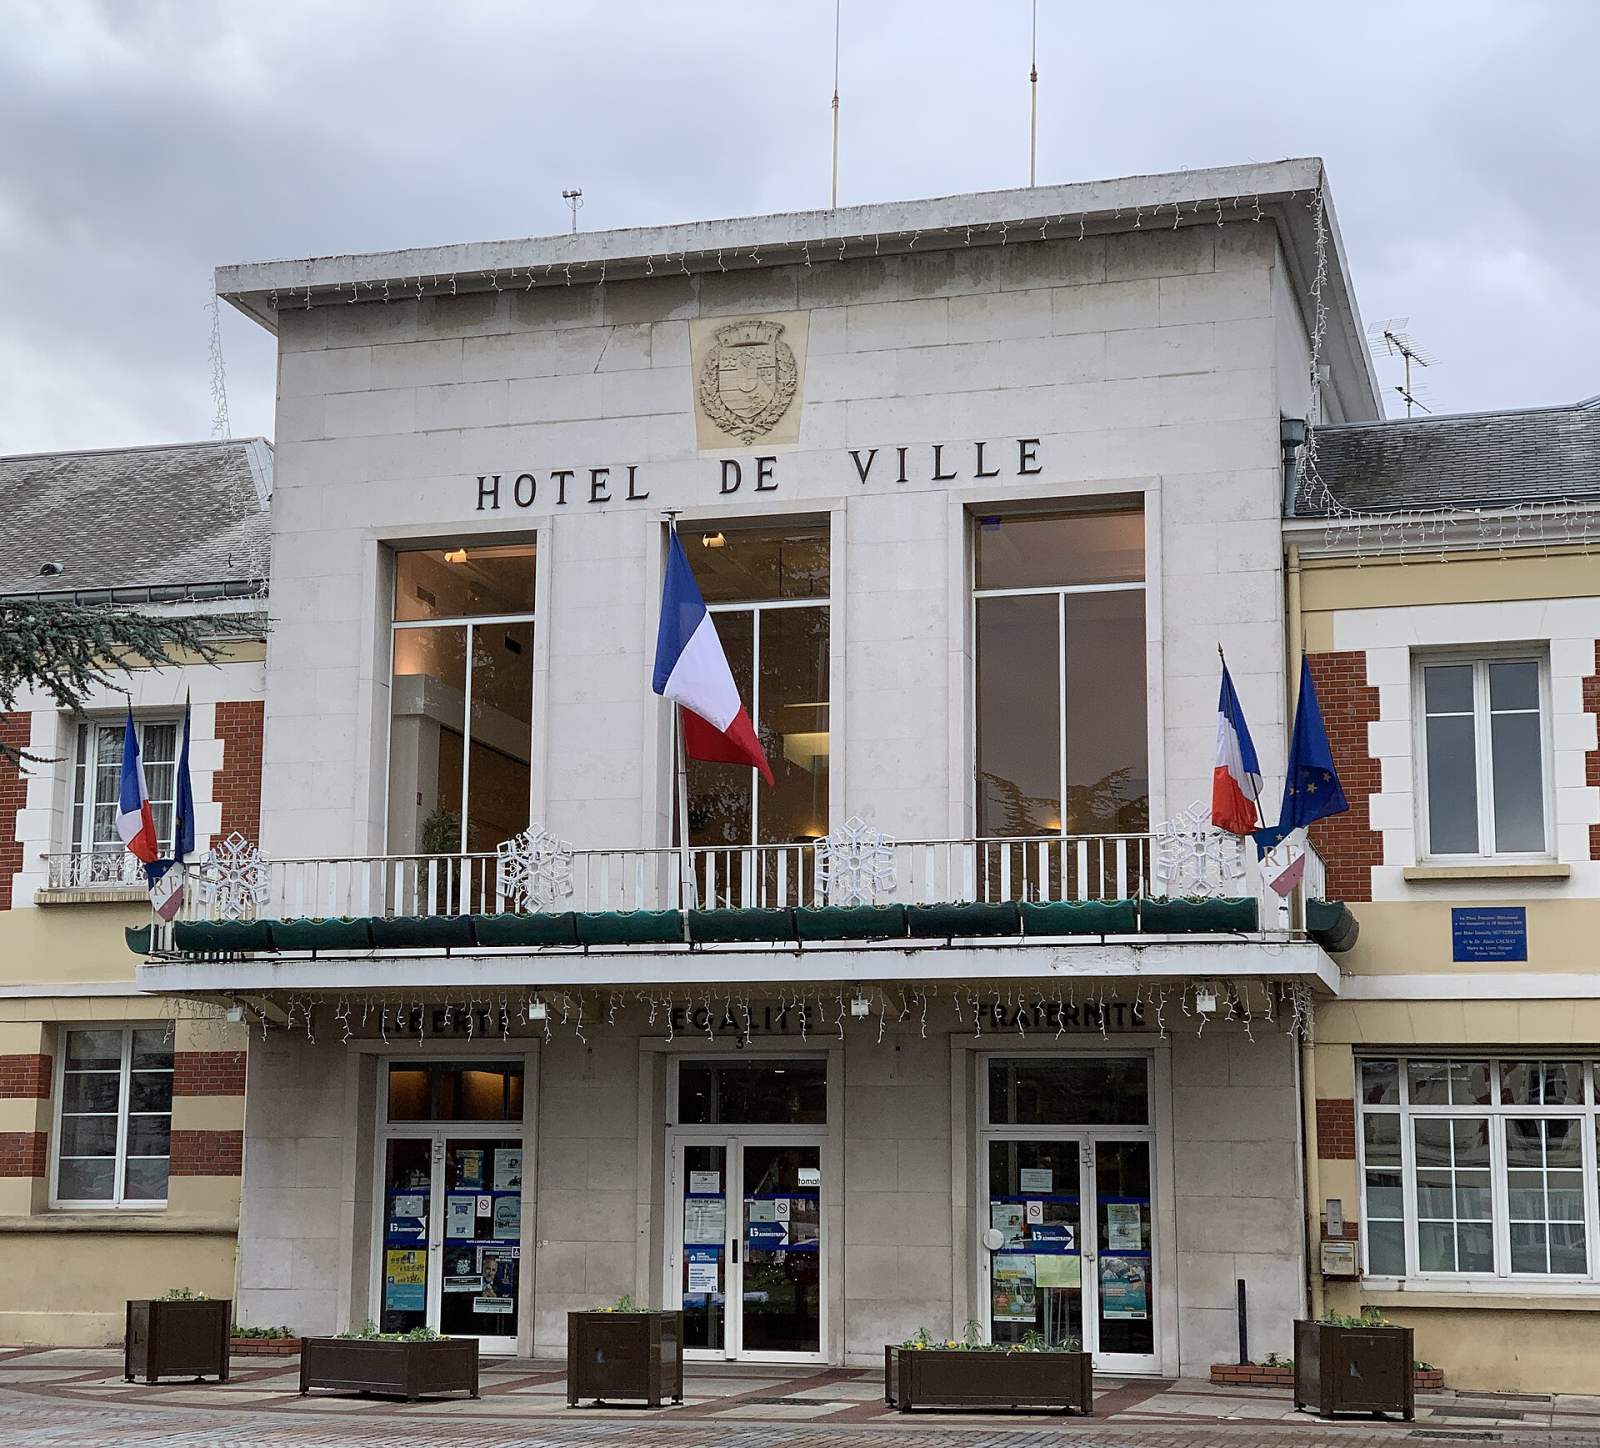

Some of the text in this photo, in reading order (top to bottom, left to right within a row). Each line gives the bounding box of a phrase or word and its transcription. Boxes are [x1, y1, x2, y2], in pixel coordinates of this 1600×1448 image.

[476, 438, 1043, 511] HOTEL DE VILLE
[735, 1036, 744, 1049] 3
